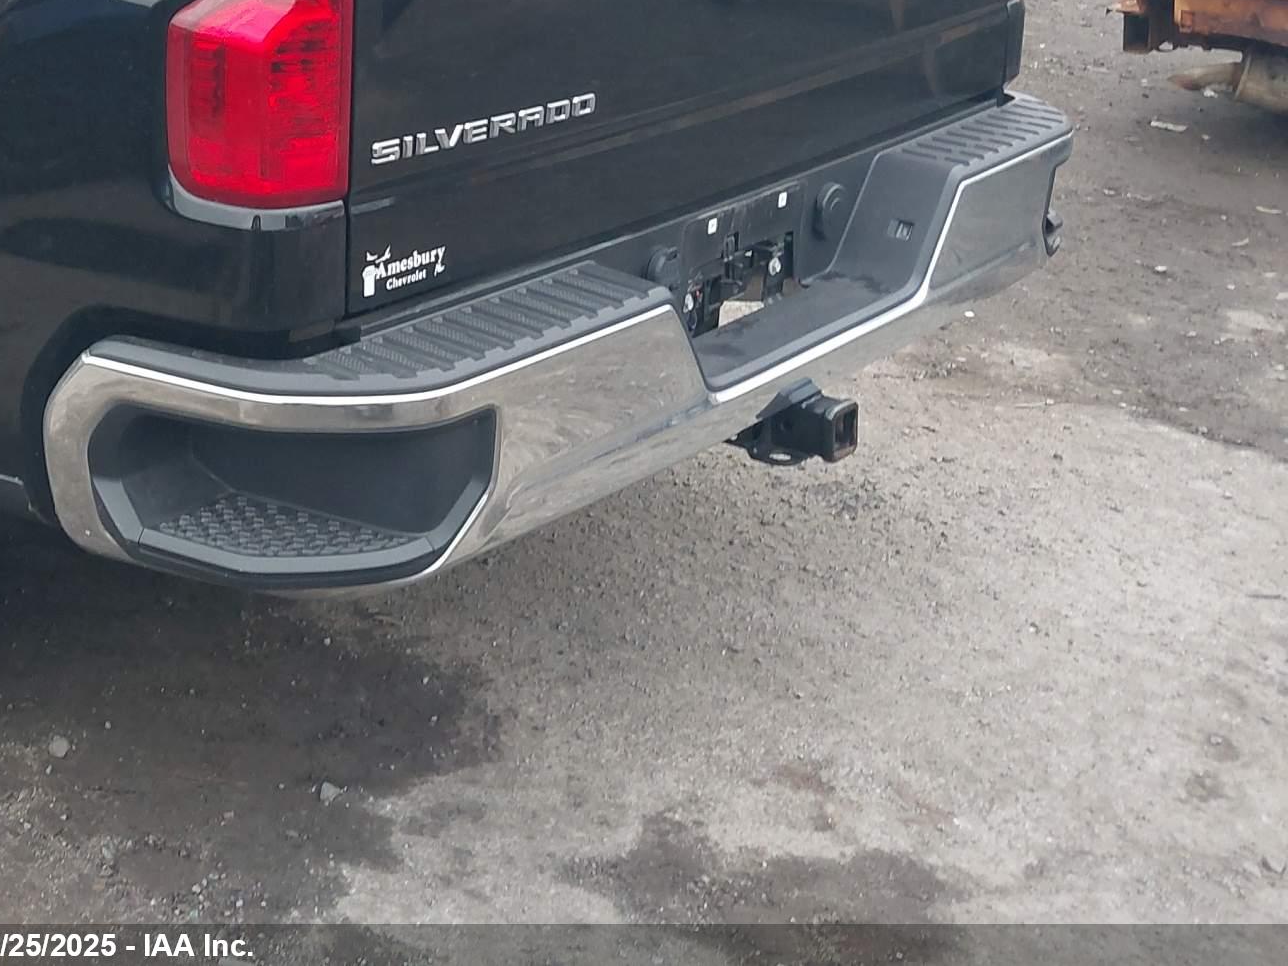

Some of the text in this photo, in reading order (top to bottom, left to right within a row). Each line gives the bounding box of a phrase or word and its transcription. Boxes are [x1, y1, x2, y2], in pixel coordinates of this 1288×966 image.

[371, 93, 596, 164] SILVERADO
[374, 245, 446, 280] Amesbury
[385, 268, 427, 291] Chevrolet
